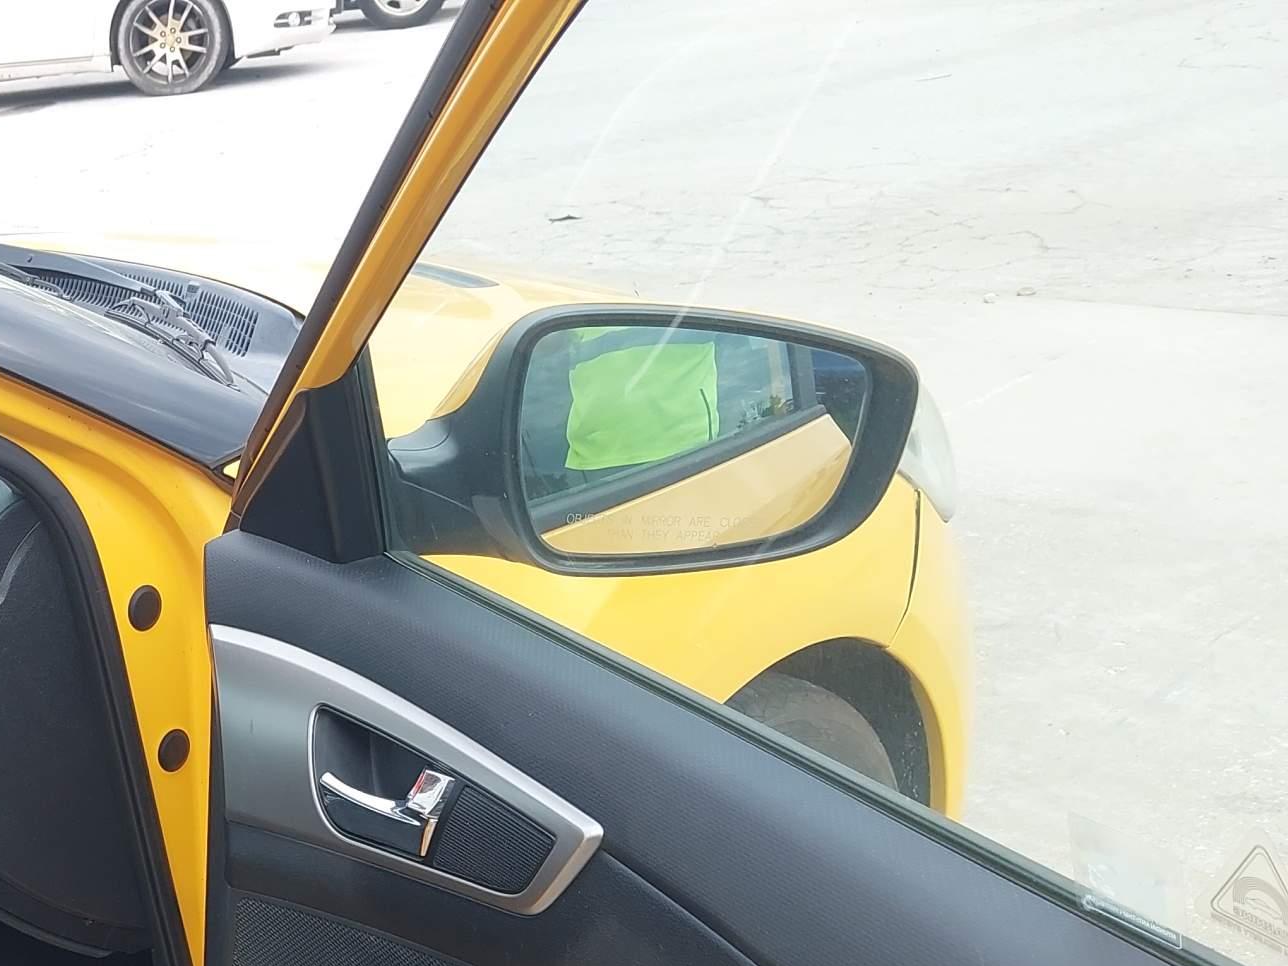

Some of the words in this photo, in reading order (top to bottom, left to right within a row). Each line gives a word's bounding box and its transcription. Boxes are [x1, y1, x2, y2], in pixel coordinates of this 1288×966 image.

[566, 513, 615, 527] OBJETS
[640, 515, 681, 528] MIRROR
[688, 515, 712, 528] ARE
[718, 516, 762, 528] CLOS
[641, 528, 670, 541] THEY
[675, 529, 721, 541] APPEAR
